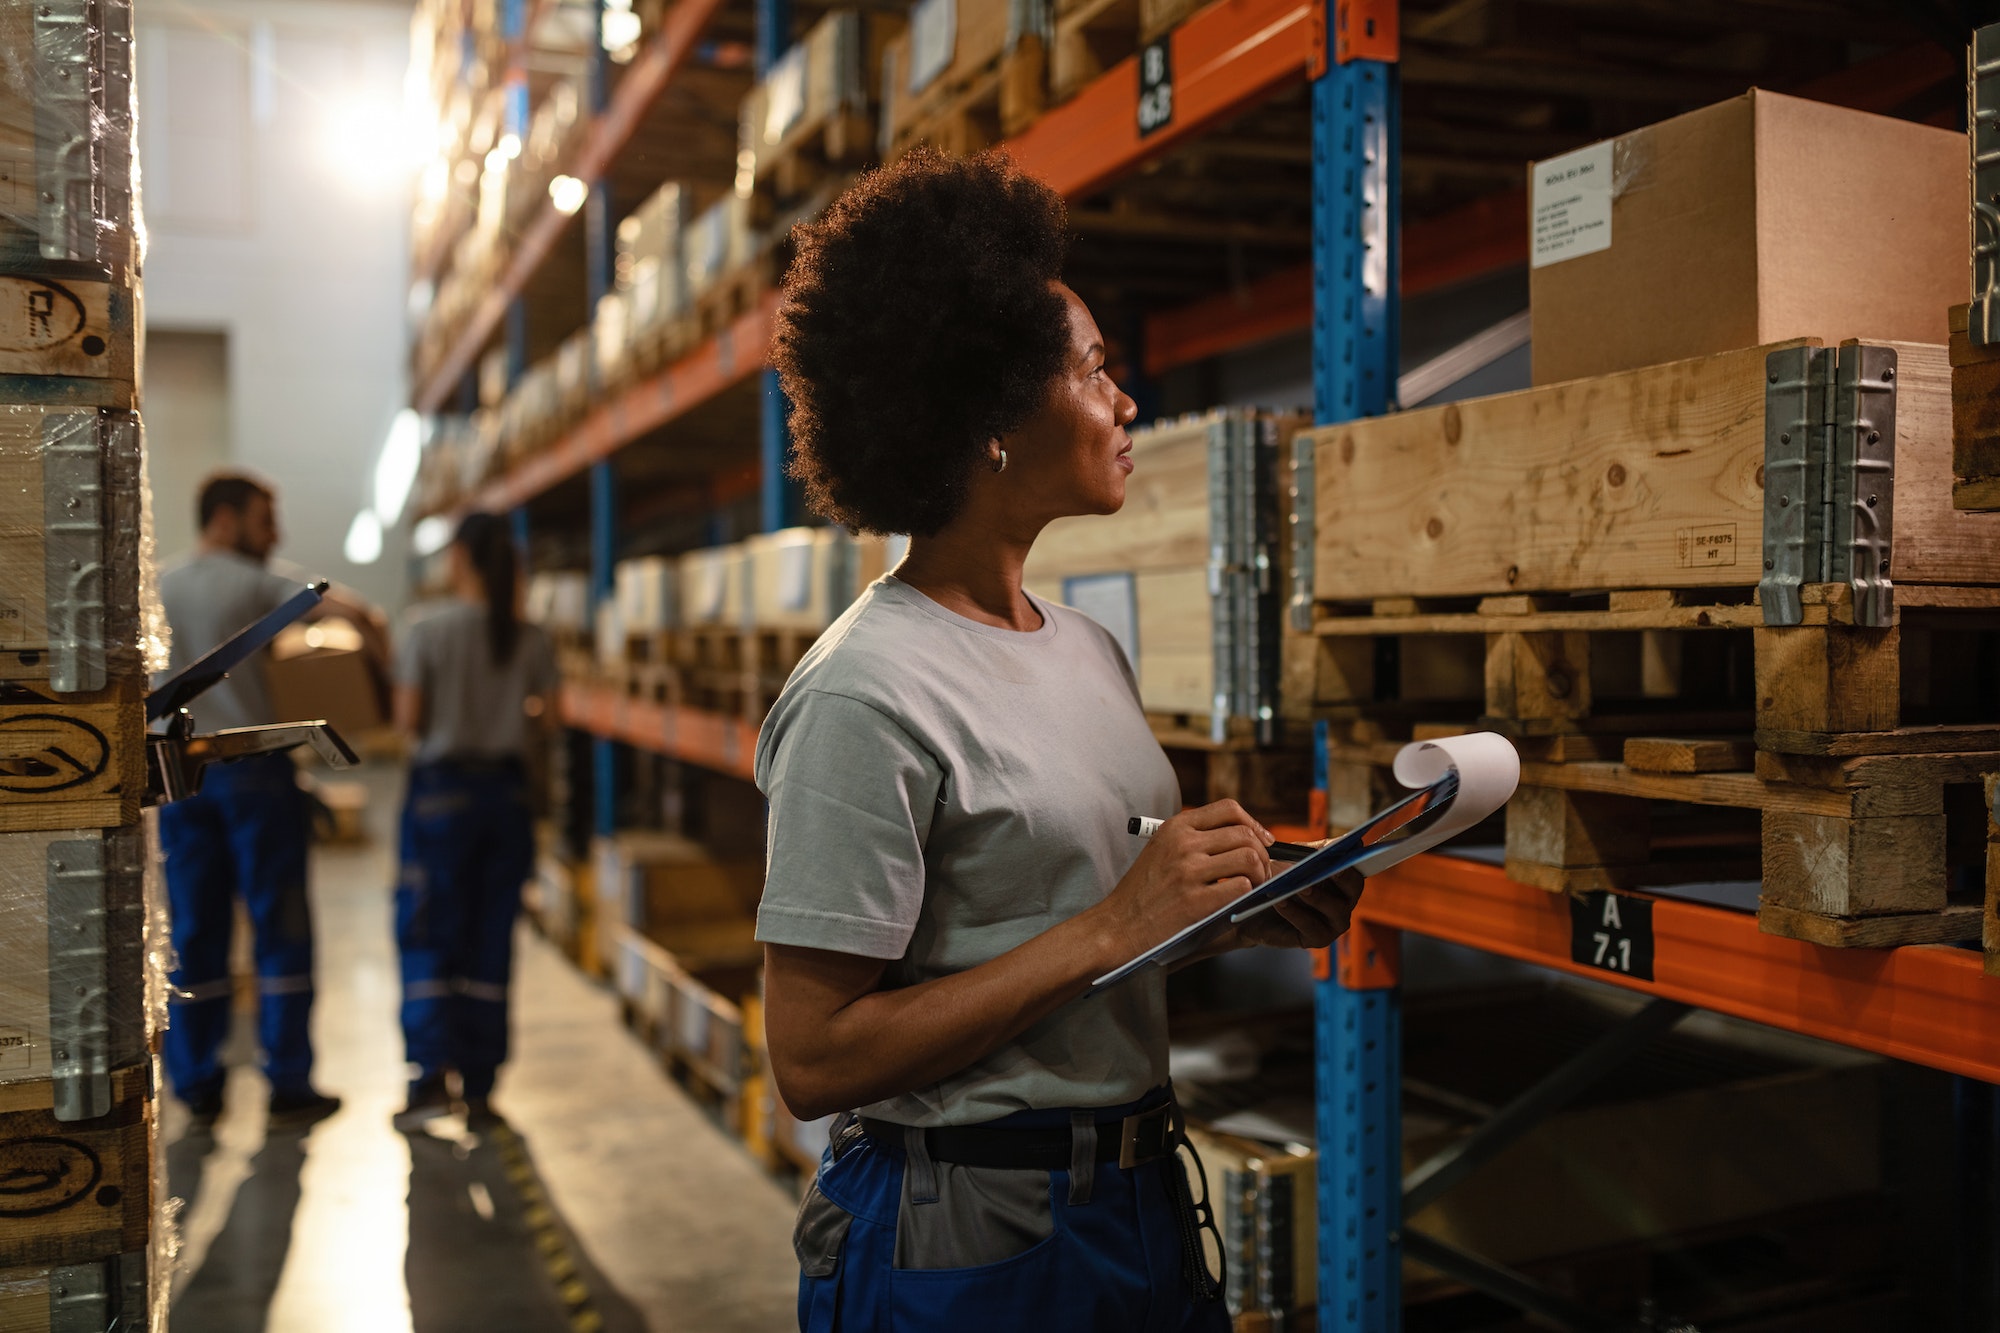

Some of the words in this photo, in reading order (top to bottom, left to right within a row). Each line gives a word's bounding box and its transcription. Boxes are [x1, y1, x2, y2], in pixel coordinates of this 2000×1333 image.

[1145, 45, 1164, 85] B
[28, 291, 54, 338] R
[1696, 534, 1732, 546] SE-F6375
[1707, 549, 1719, 559] HT
[1602, 894, 1622, 929] A
[1593, 931, 1632, 972] 7.1
